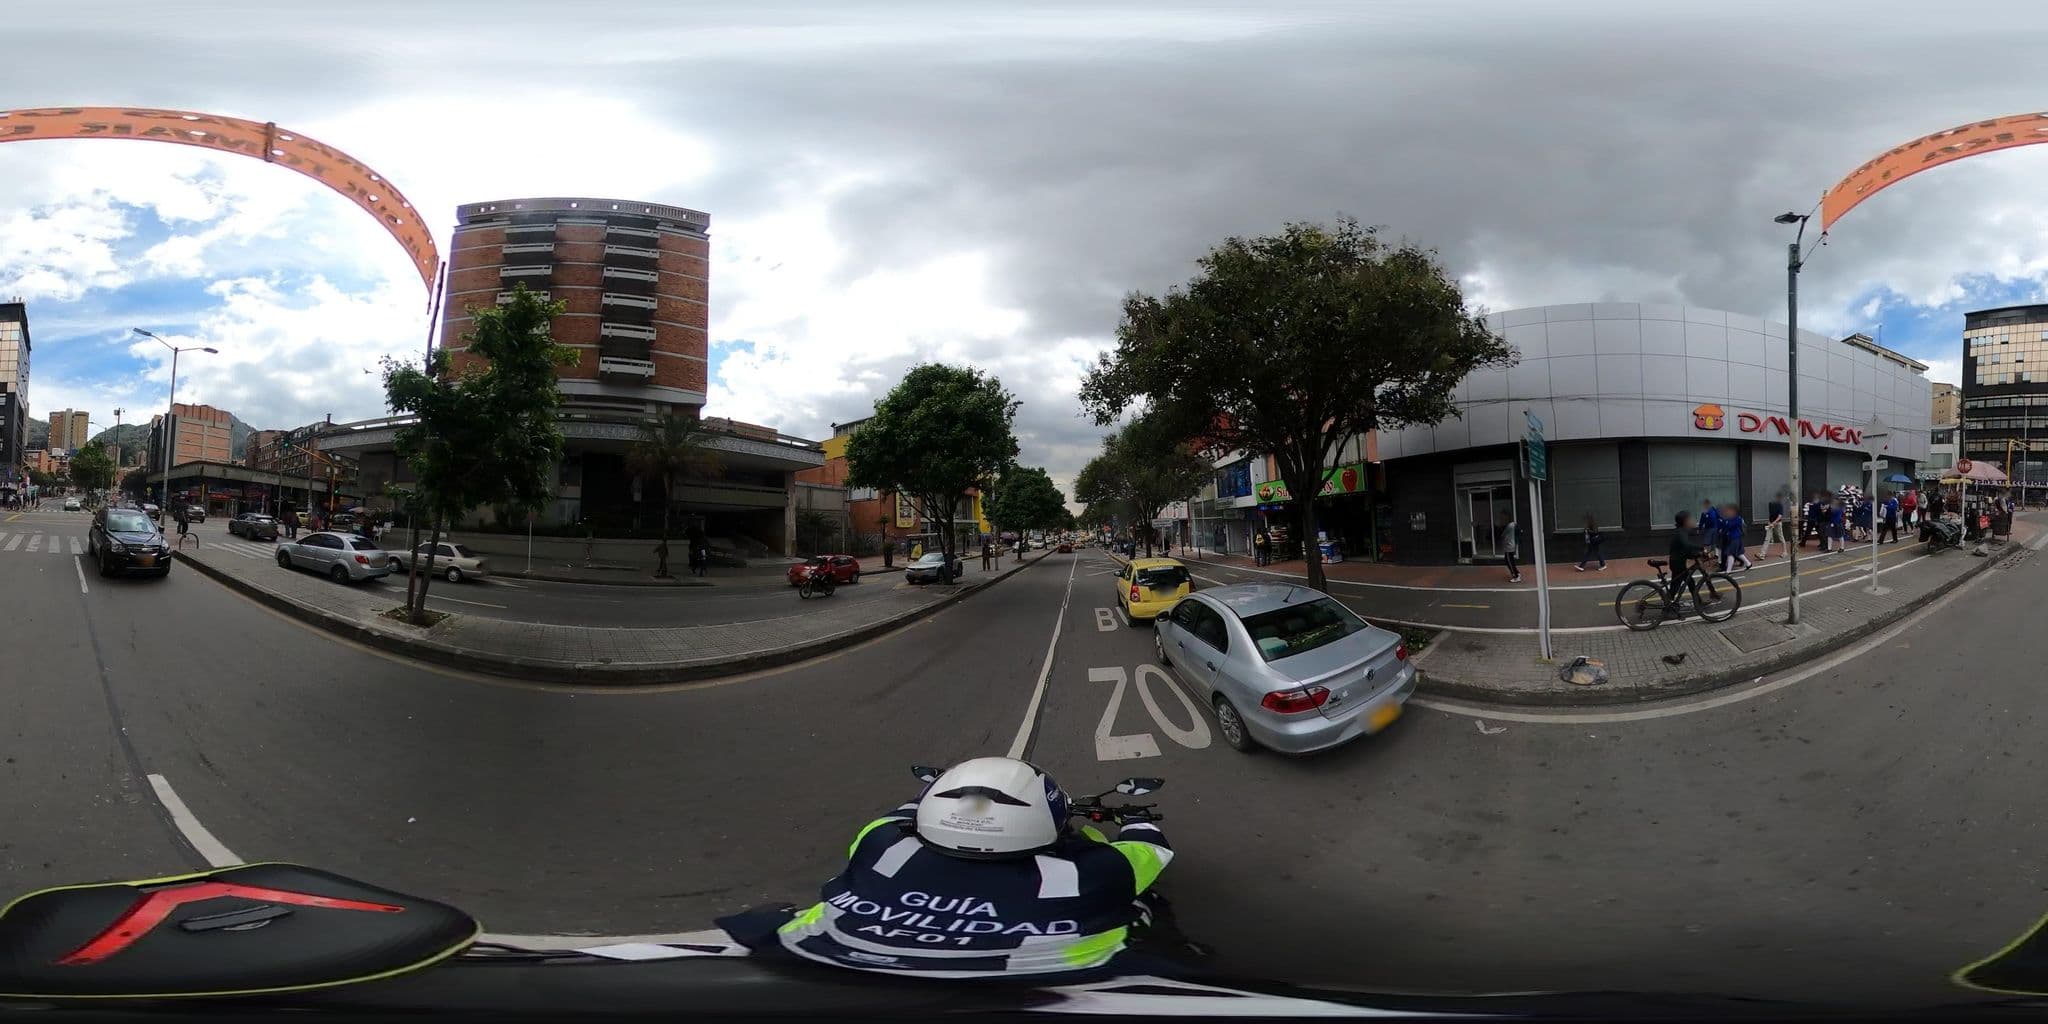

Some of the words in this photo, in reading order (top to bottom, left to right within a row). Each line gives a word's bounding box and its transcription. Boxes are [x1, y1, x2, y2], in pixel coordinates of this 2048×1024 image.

[1738, 412, 1888, 450] DAVIVIEN
[829, 891, 1079, 935] MOVILIDAD
[900, 891, 998, 917] GUÍA
[857, 925, 975, 946] AF01
